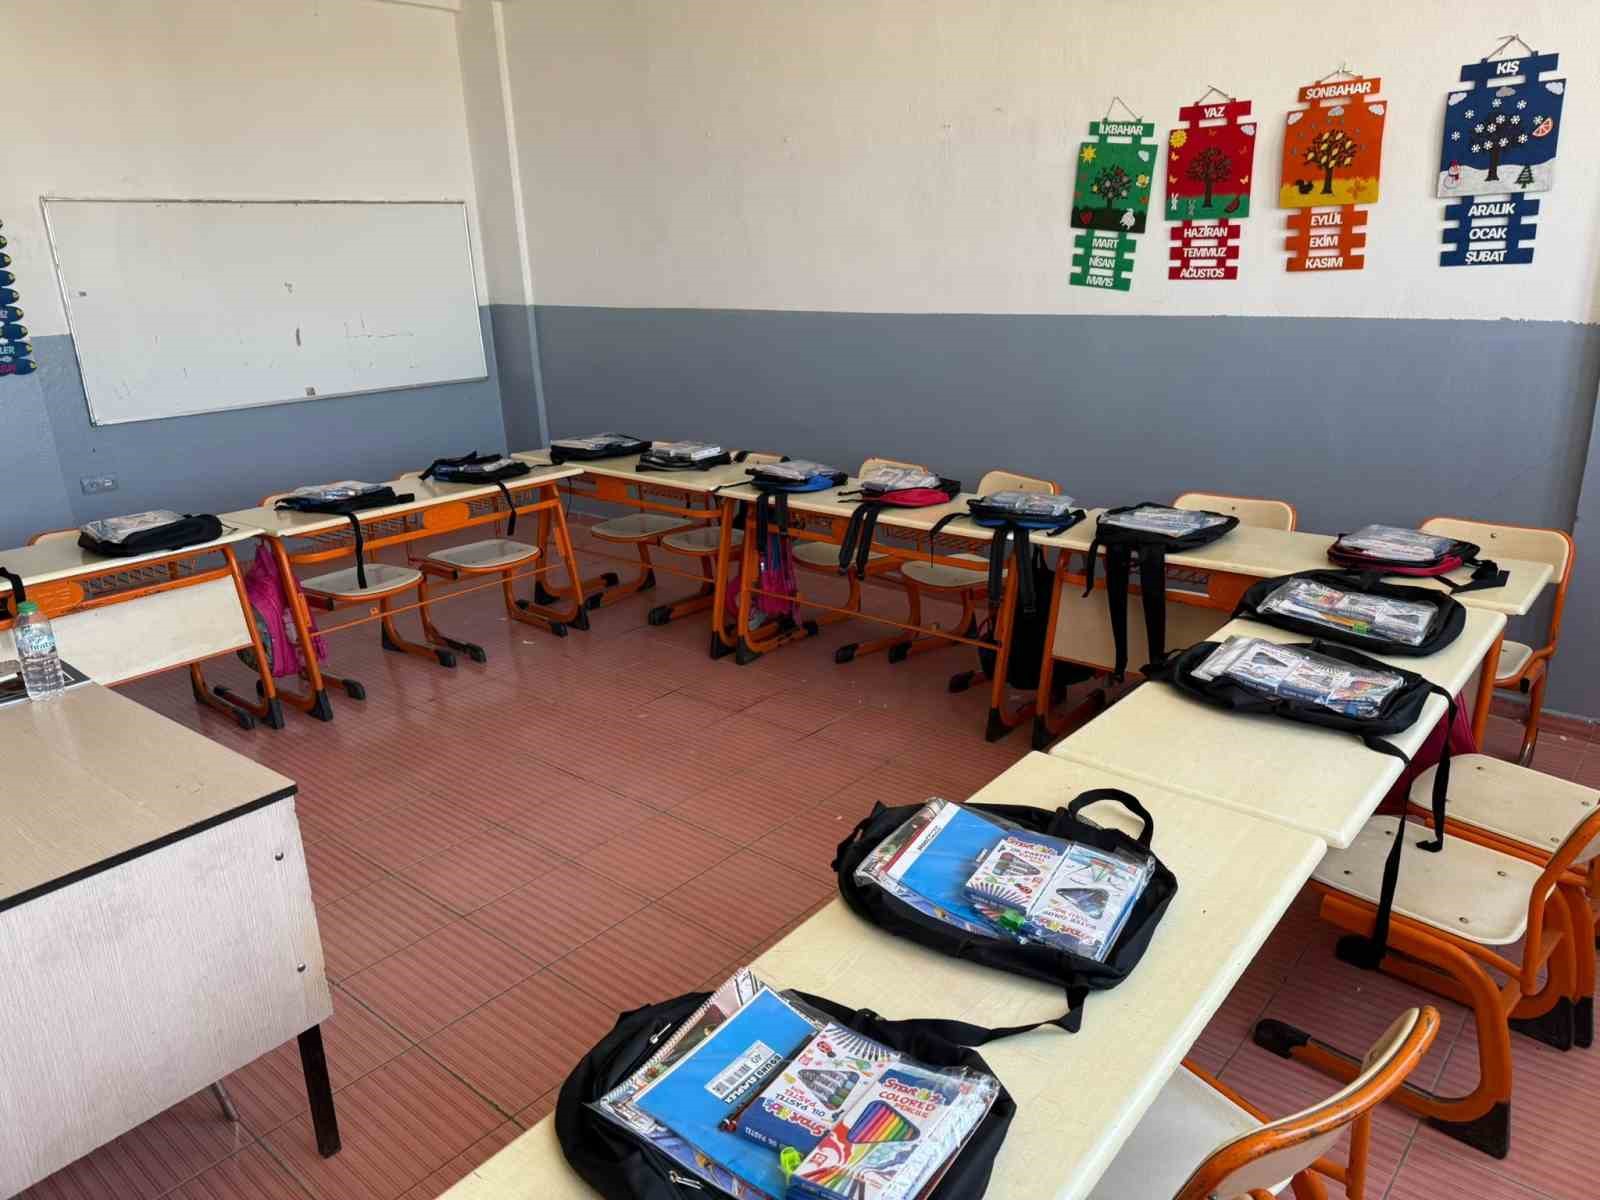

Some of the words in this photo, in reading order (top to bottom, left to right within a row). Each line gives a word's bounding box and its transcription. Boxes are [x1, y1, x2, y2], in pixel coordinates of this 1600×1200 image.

[1496, 60, 1519, 75] KIŞ
[1305, 81, 1371, 100] SONBAHAR
[1204, 106, 1225, 118] YAZ
[1468, 202, 1516, 217] ARALIK
[1310, 211, 1343, 227] EYLÜL
[1184, 226, 1228, 238] HAZİRAN
[1469, 227, 1507, 240] OCAK
[1092, 238, 1119, 249] MART
[1309, 234, 1338, 248] EKİM
[1183, 247, 1227, 258] TEMMUZ
[1465, 249, 1508, 263] ŞUBAT
[1089, 255, 1116, 269] NİSAN
[1305, 255, 1344, 269] KASIM
[1180, 265, 1225, 278] AĞUSTOS
[879, 1090, 937, 1112] COLORED
